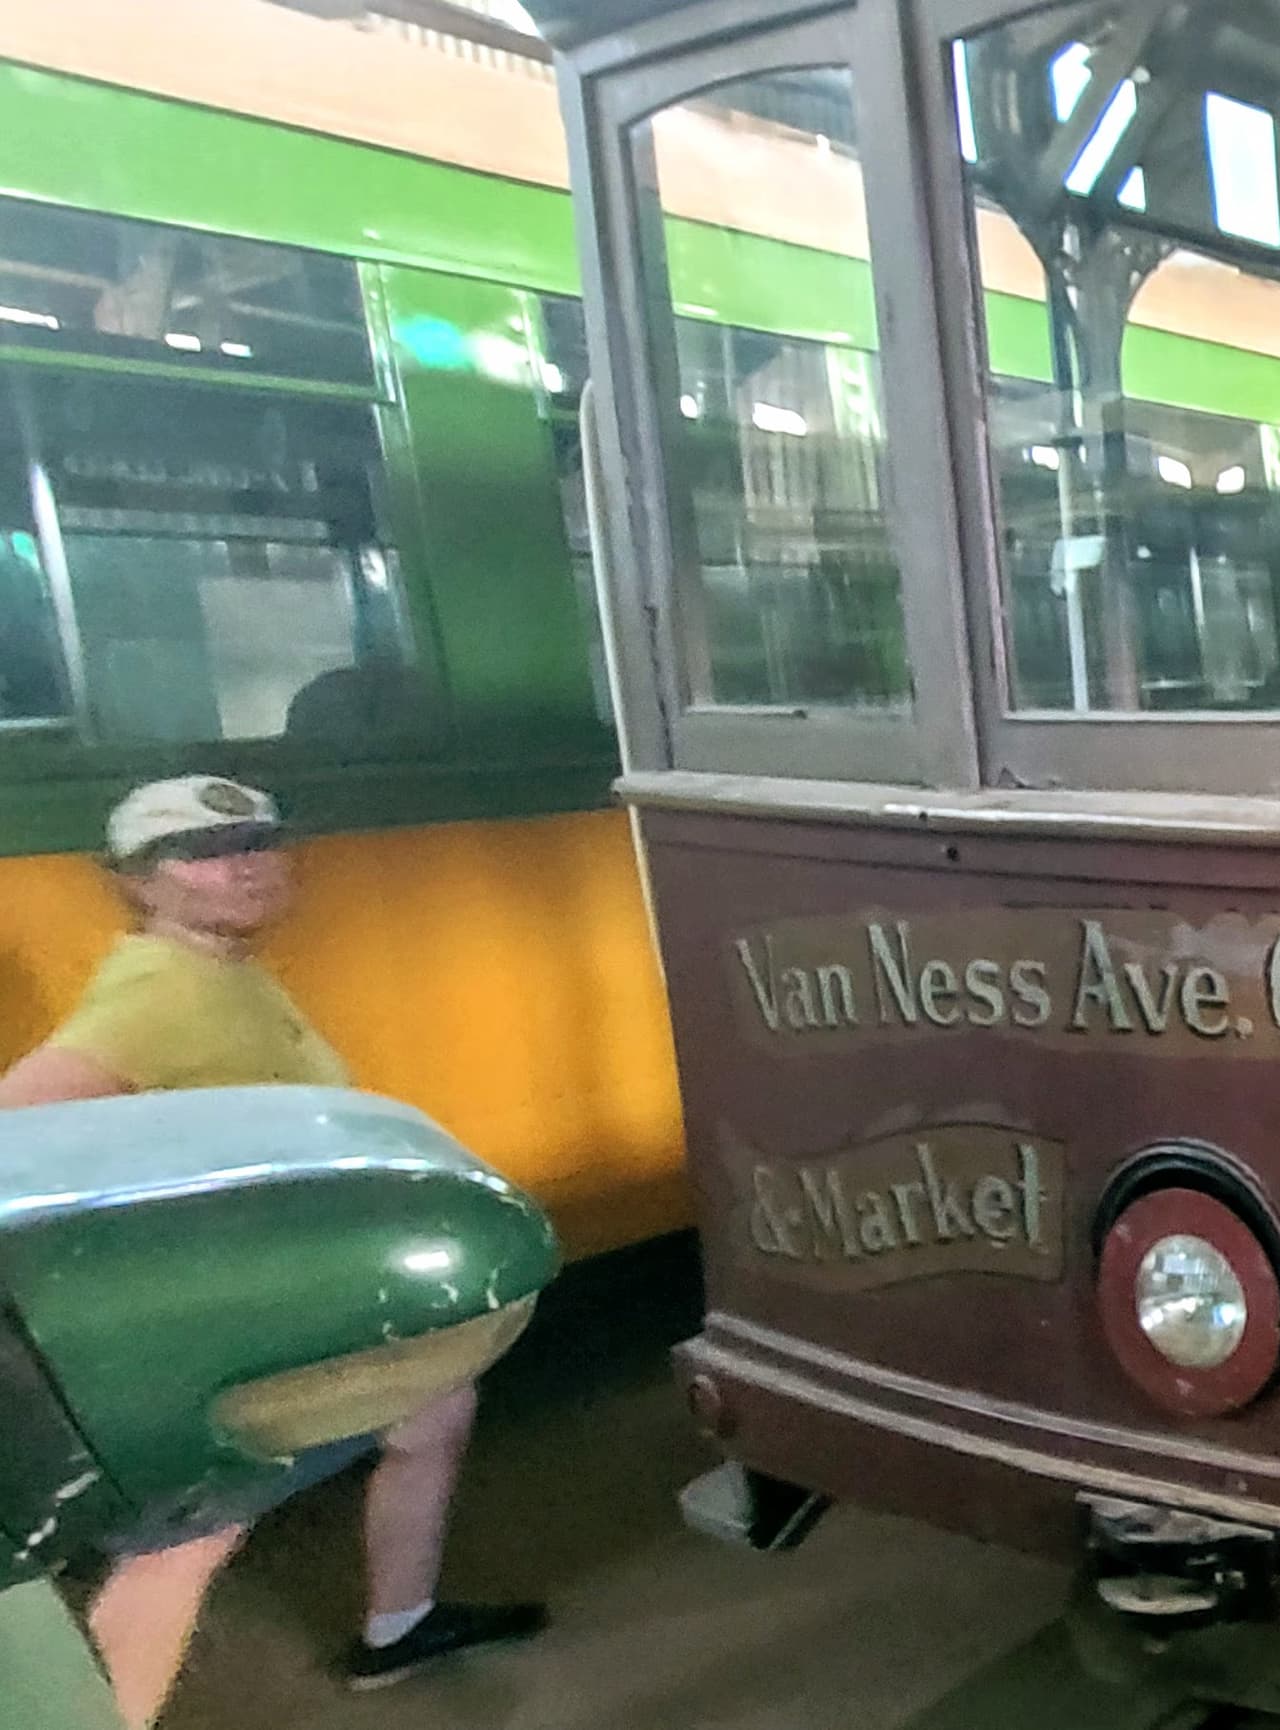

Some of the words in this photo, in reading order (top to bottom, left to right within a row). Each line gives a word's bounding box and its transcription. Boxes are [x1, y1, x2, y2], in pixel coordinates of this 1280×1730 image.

[736, 935, 860, 1032] Van
[867, 918, 1053, 1030] Ness
[1064, 919, 1255, 1040] Ave.
